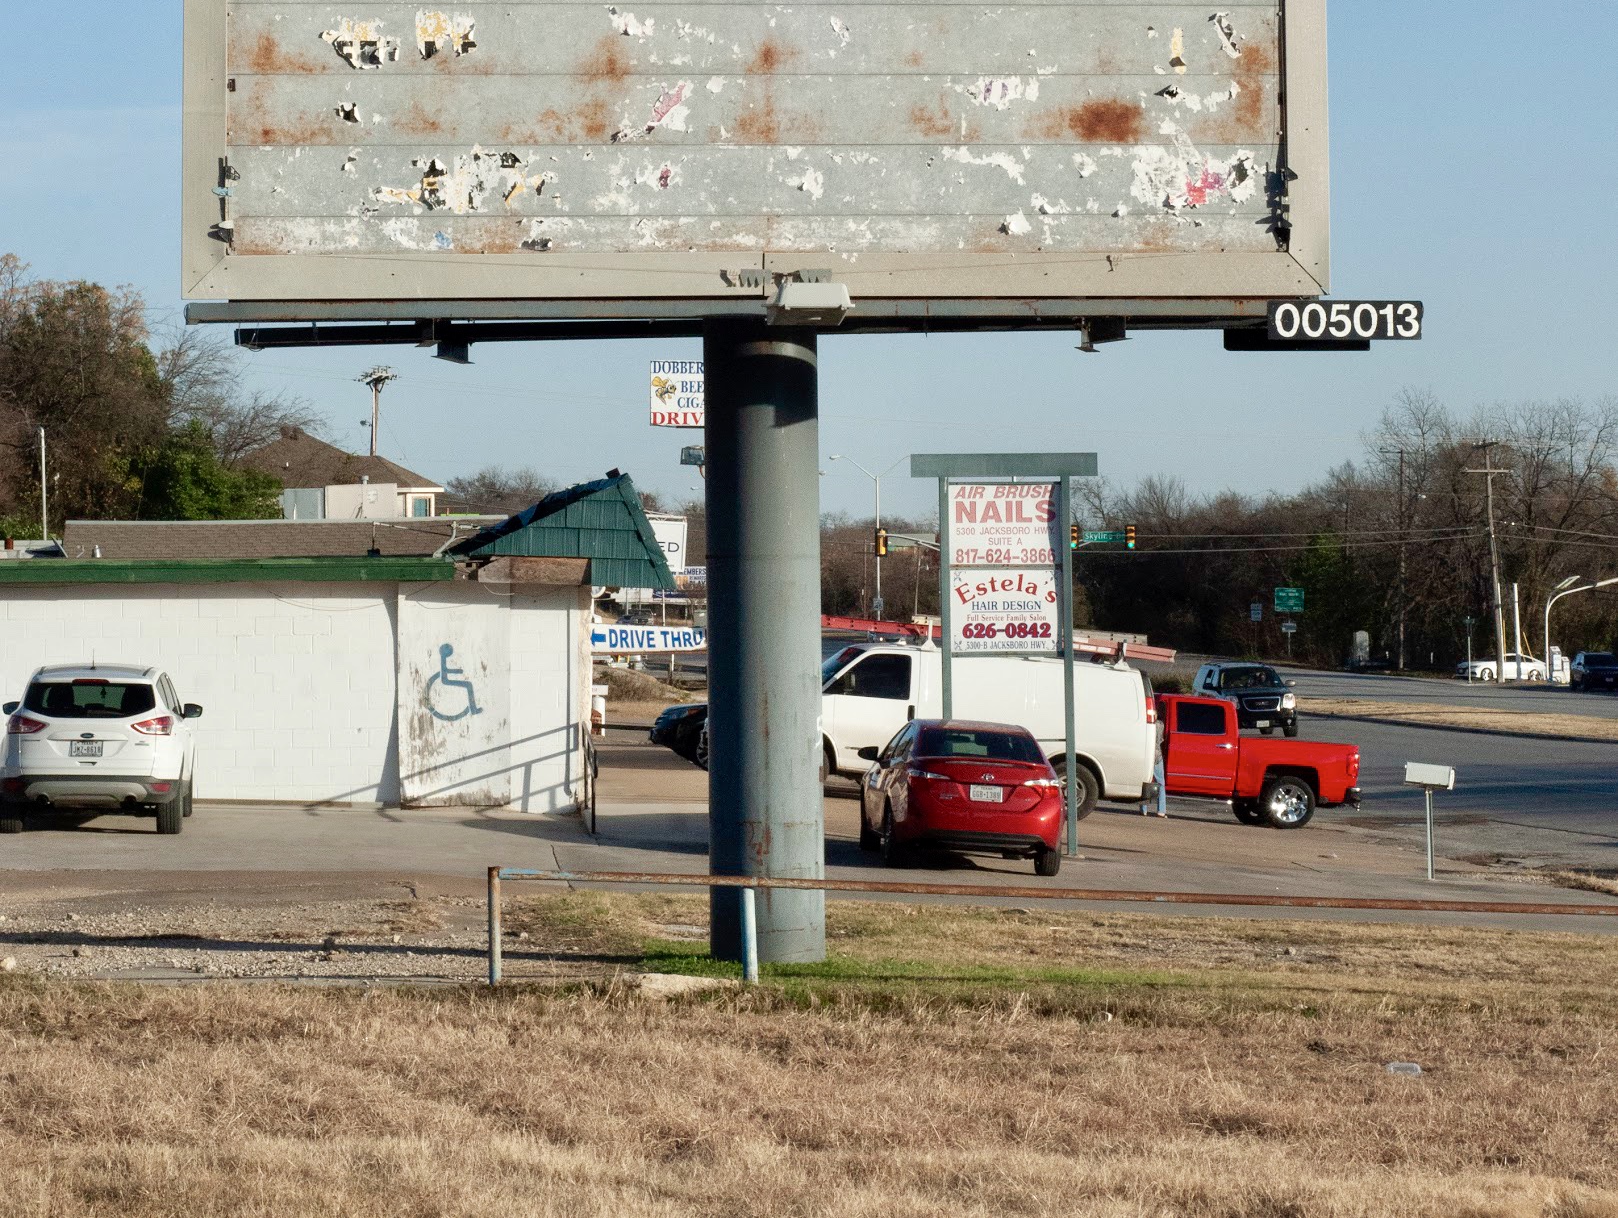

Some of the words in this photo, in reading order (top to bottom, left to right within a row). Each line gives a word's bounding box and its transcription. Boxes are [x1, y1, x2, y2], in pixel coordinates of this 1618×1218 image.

[1275, 303, 1420, 338] 005013
[955, 486, 986, 499] AIR
[993, 485, 1055, 499] BRUSH
[955, 500, 1057, 524] NAILS
[956, 527, 976, 536] 5300
[980, 526, 1031, 535] JACKSBORO
[988, 537, 1013, 546] SUITE
[1017, 537, 1023, 546] A
[955, 548, 1056, 564] 817-624-3866
[954, 573, 1058, 604] Estela's
[972, 600, 998, 610] HAIR
[1002, 600, 1042, 610] DESIGN
[966, 614, 979, 622] Full
[981, 614, 1004, 622] Service
[1006, 614, 1027, 623] Family
[1029, 613, 1047, 622] Salon
[962, 622, 1052, 639] 626-0842
[608, 629, 656, 649] DRIVE
[660, 630, 703, 648] THRU
[990, 641, 1028, 650] JACKSBORO
